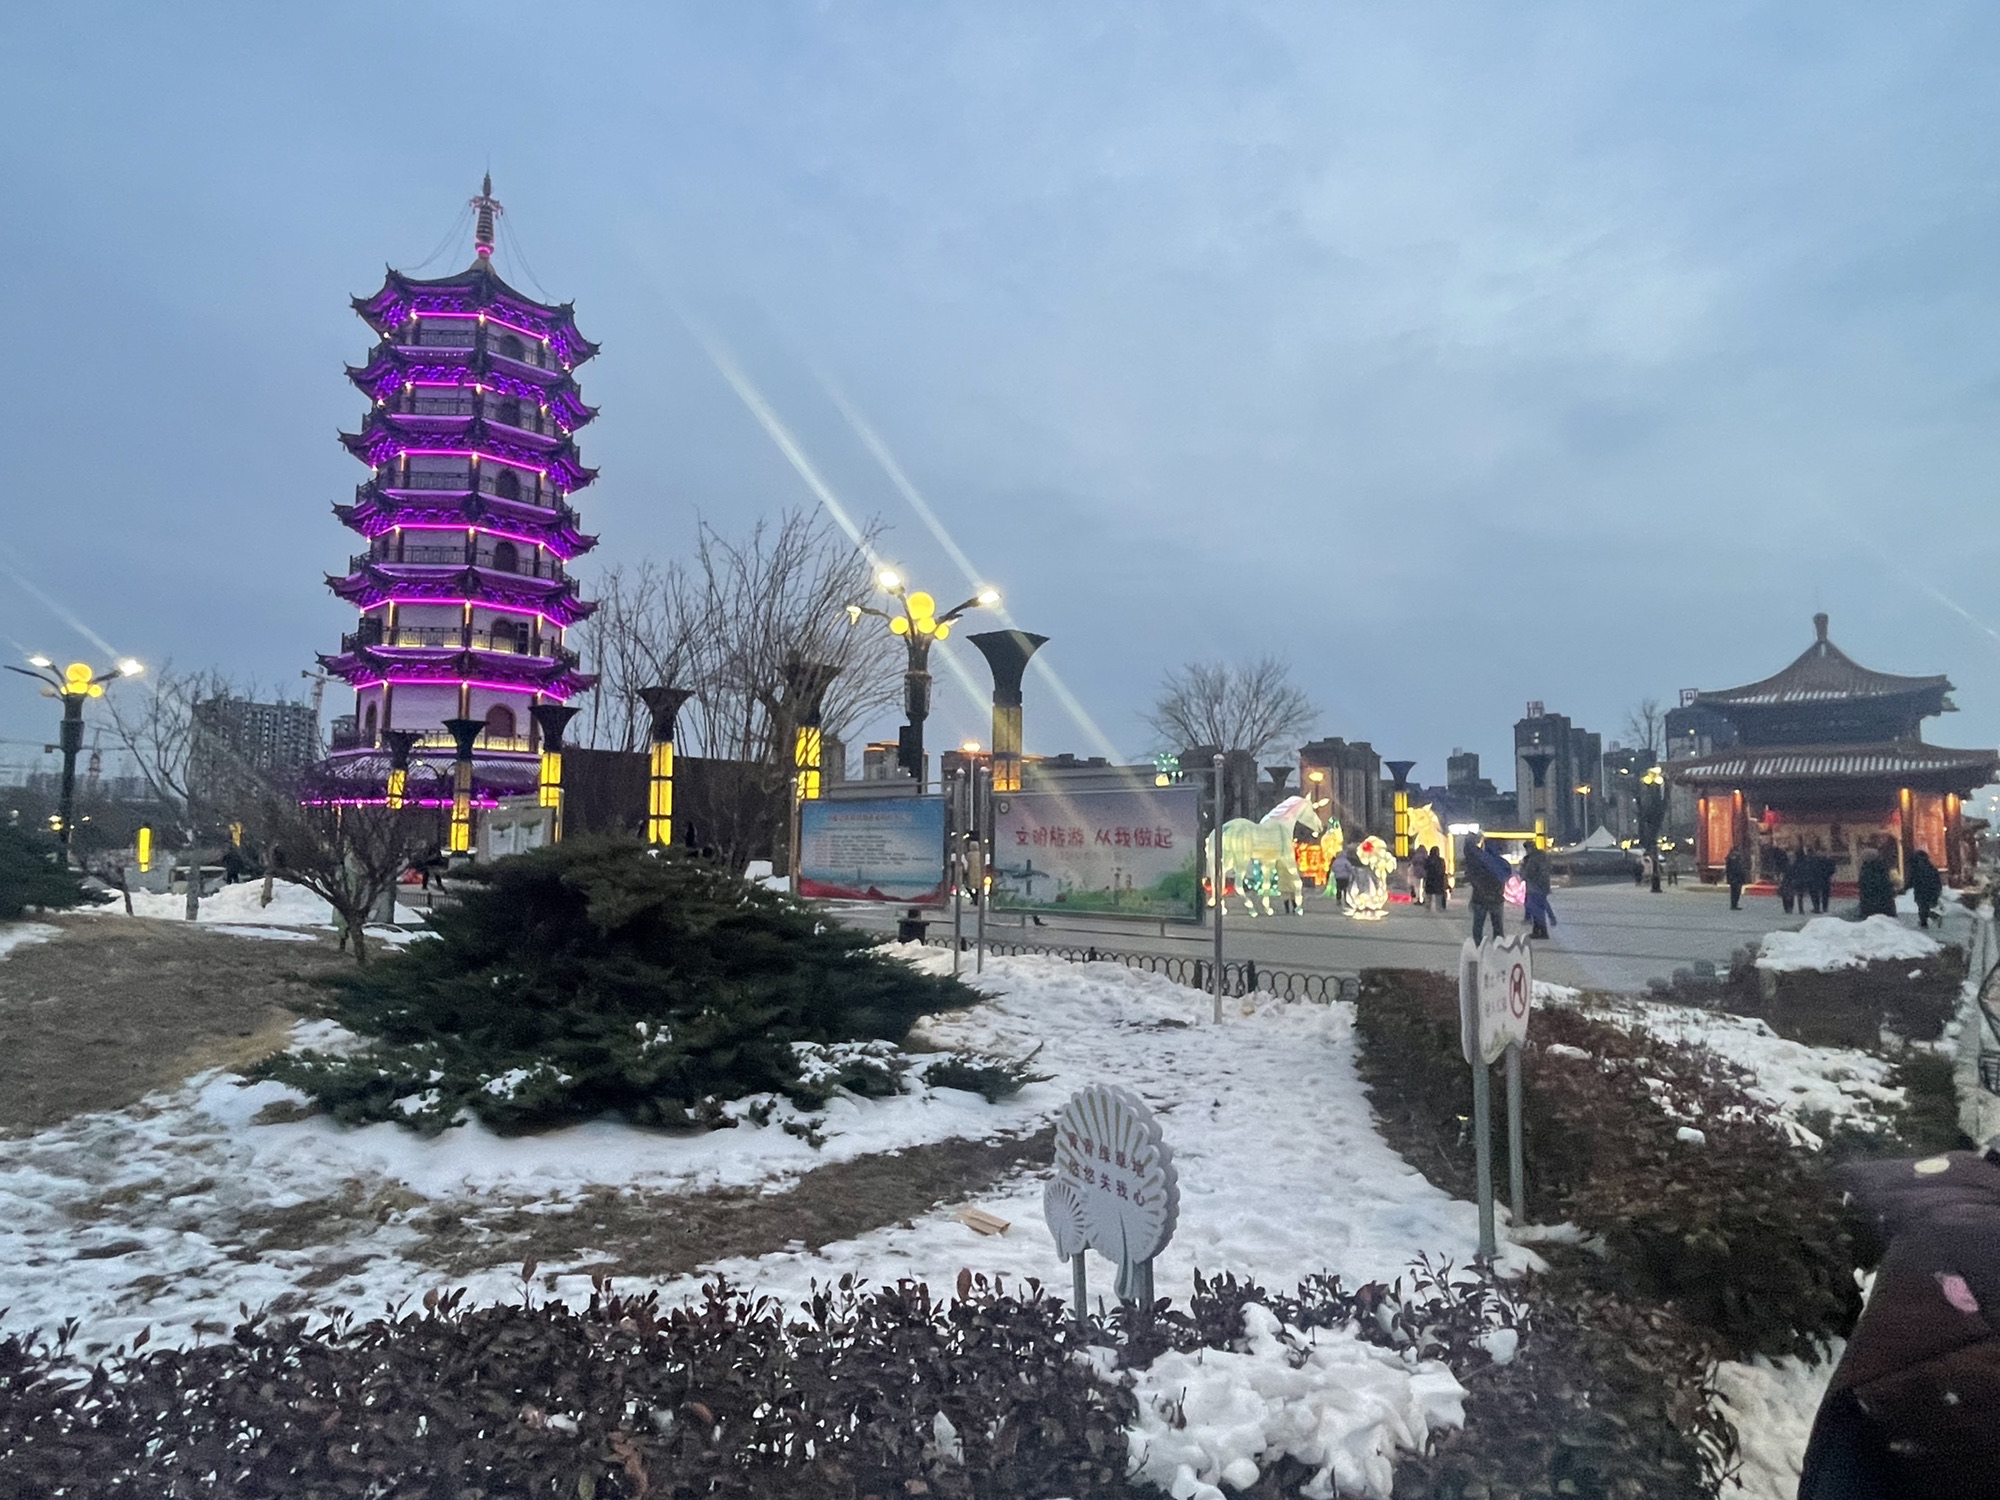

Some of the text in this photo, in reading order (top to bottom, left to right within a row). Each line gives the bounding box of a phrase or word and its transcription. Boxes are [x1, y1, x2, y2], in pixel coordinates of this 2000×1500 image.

[1015, 826, 1173, 849] 文明旅游 从我做起
